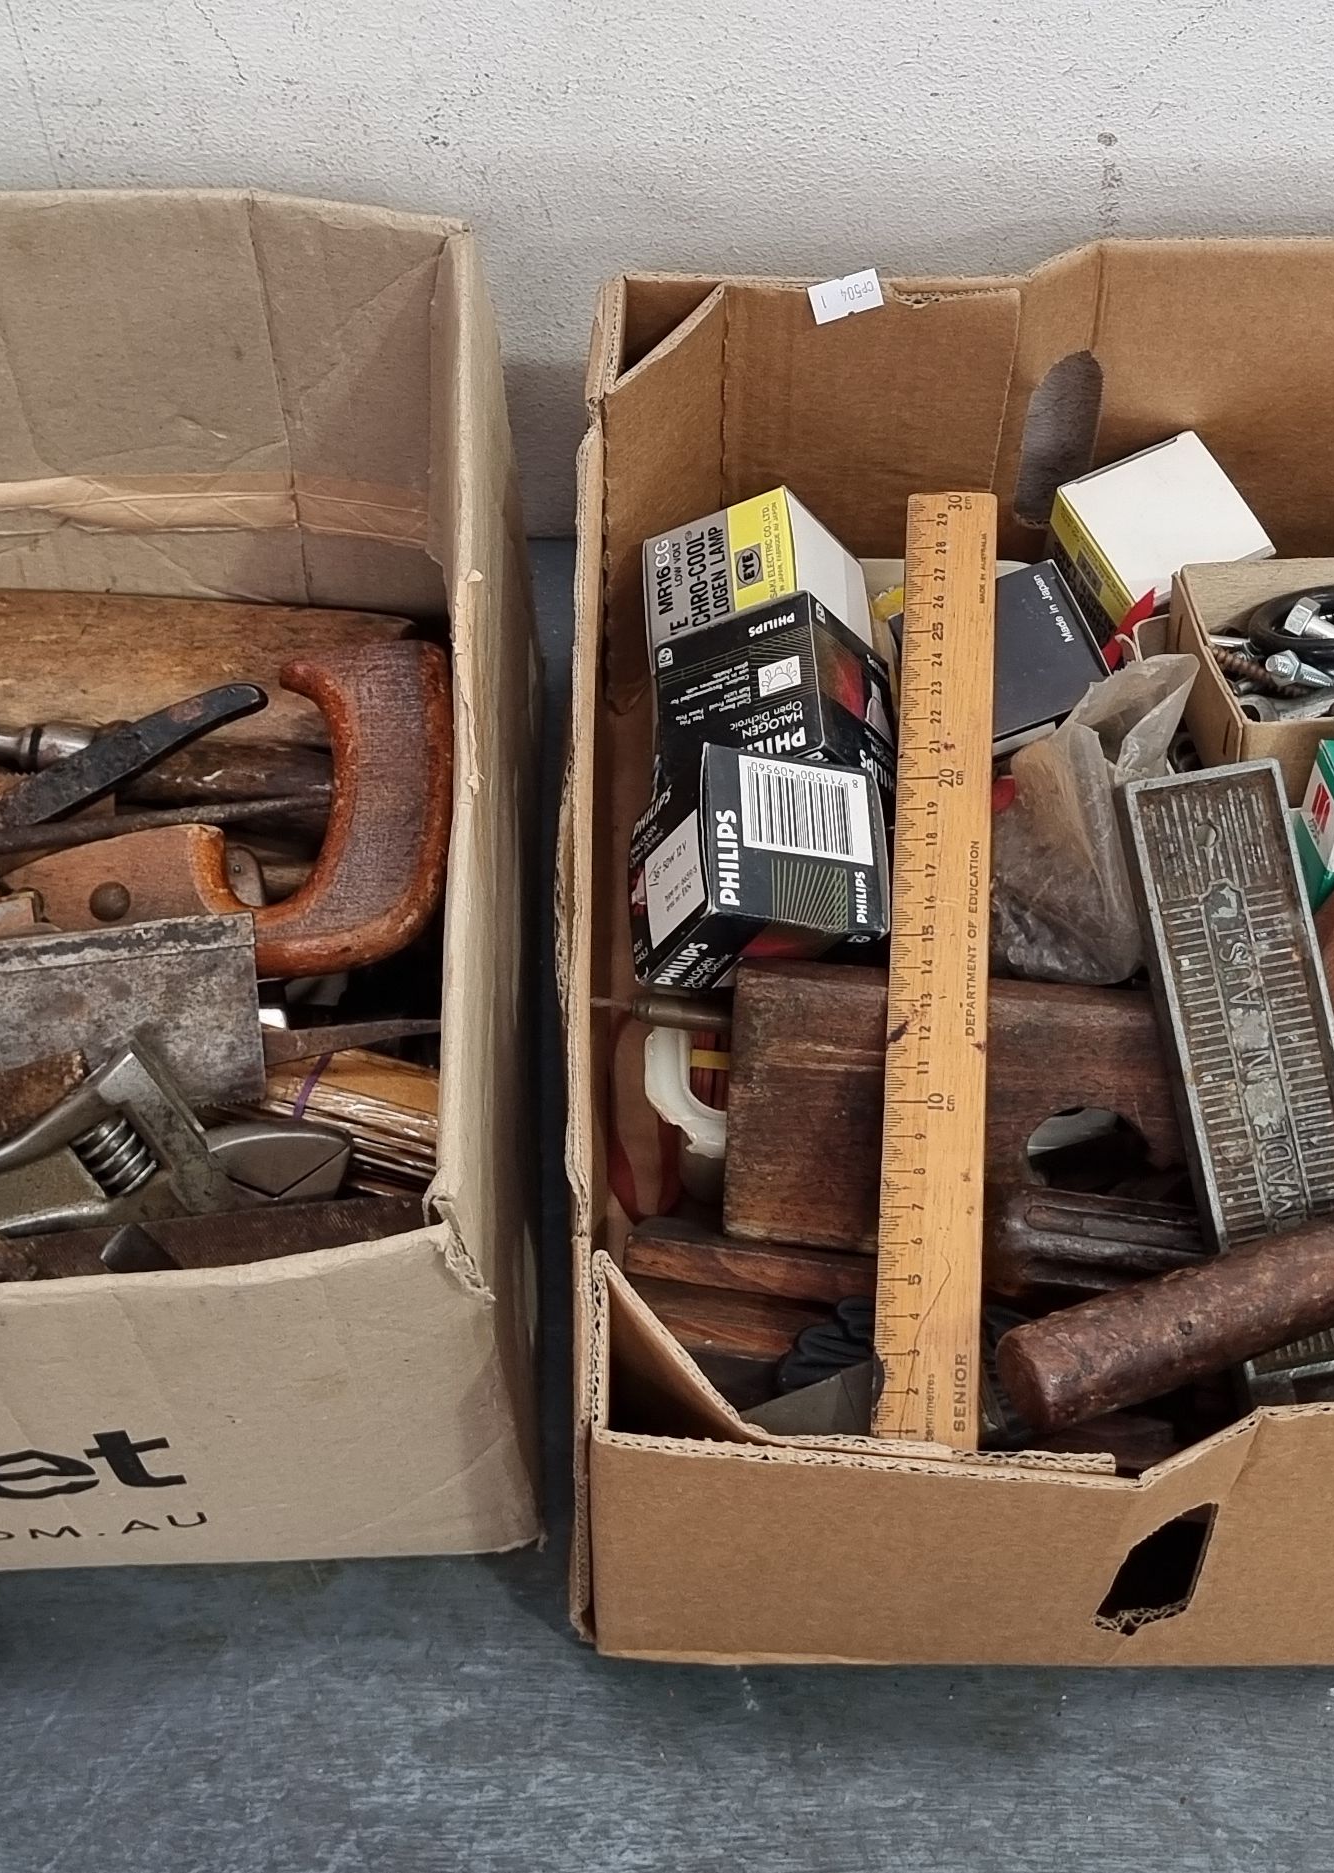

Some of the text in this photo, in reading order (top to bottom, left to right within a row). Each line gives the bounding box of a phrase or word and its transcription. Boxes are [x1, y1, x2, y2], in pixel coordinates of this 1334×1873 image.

[841, 281, 875, 302] CP504
[948, 494, 962, 512] 30
[936, 512, 948, 526] 29
[707, 526, 725, 564] LAMP
[935, 541, 947, 554] 28
[671, 543, 684, 587] LOW VOLT
[740, 551, 756, 581] EYE
[765, 539, 775, 577] ELECTRIC
[654, 539, 675, 615] MR16CG
[933, 568, 946, 581] 27
[1033, 574, 1053, 601] Japan
[932, 596, 944, 609] 26
[748, 612, 796, 637] PHILIPS
[931, 622, 944, 641] 25
[1055, 615, 1075, 643] Made
[931, 652, 942, 667] 24
[931, 680, 942, 695] 23
[730, 700, 802, 730] Open Dichroic
[930, 709, 942, 724] 22
[742, 709, 804, 739] HALOGEN
[929, 740, 940, 754] 21
[751, 761, 859, 788] 8 711500 409560
[938, 768, 964, 788] 20 cm
[631, 784, 673, 840] PHILIPS
[926, 801, 939, 816] 19
[926, 832, 938, 846] 18
[715, 809, 741, 907] PHILIPS
[924, 863, 937, 878] 17
[854, 871, 868, 924] PHILIPS
[924, 895, 936, 910] 16
[922, 924, 935, 942] 15
[965, 840, 980, 1037] DEPARTMENT OF EDUCATION
[653, 942, 709, 986] PHILIPS
[921, 959, 933, 975] 14
[919, 992, 932, 1008] 13
[918, 1025, 931, 1040] 12
[917, 1061, 929, 1075] 11
[927, 1092, 955, 1112] 10 cm
[914, 1132, 926, 1141] 9
[913, 1167, 926, 1175] 8
[1253, 1120, 1308, 1218] MADE
[912, 1202, 924, 1212] 7
[912, 1236, 923, 1246] 6
[907, 1274, 922, 1285] 5
[909, 1312, 920, 1320] 4
[907, 1348, 920, 1357] 3
[907, 1387, 919, 1395] 2
[953, 1353, 967, 1433] SENIOR
